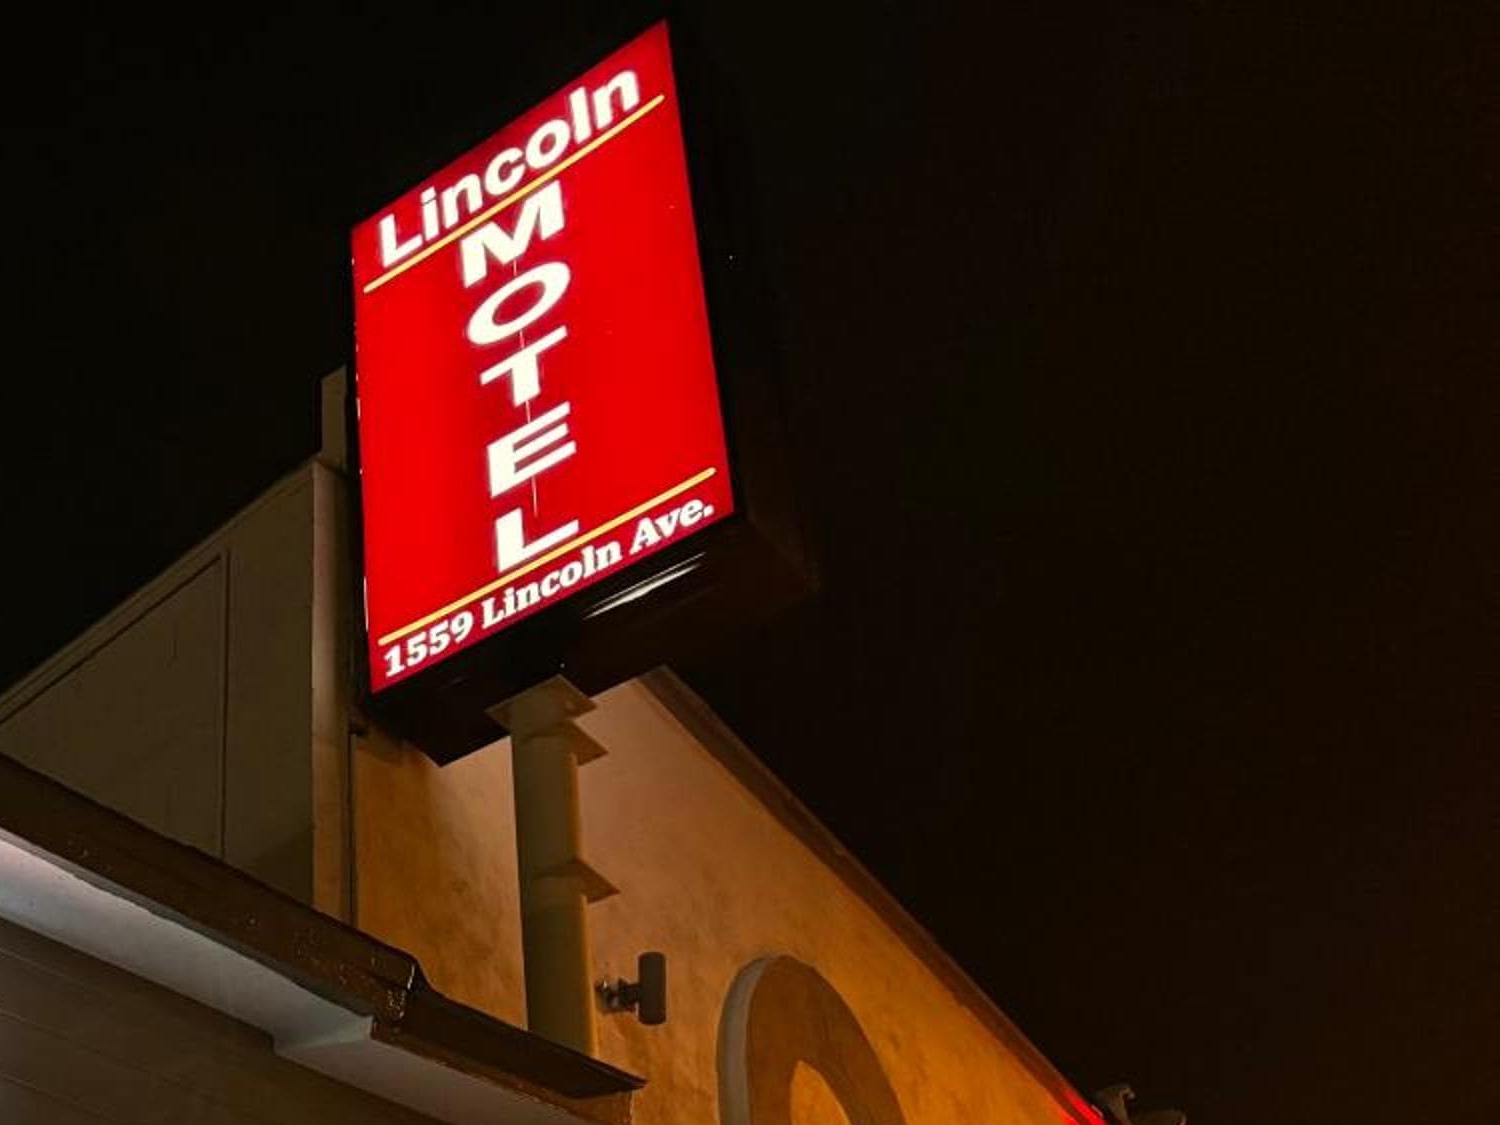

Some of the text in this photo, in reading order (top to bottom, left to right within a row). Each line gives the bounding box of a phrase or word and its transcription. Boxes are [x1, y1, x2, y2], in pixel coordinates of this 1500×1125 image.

[377, 68, 640, 268] Lincoln
[461, 179, 579, 575] MOTEL
[384, 497, 714, 677] 1559 Lincoln Ave.
